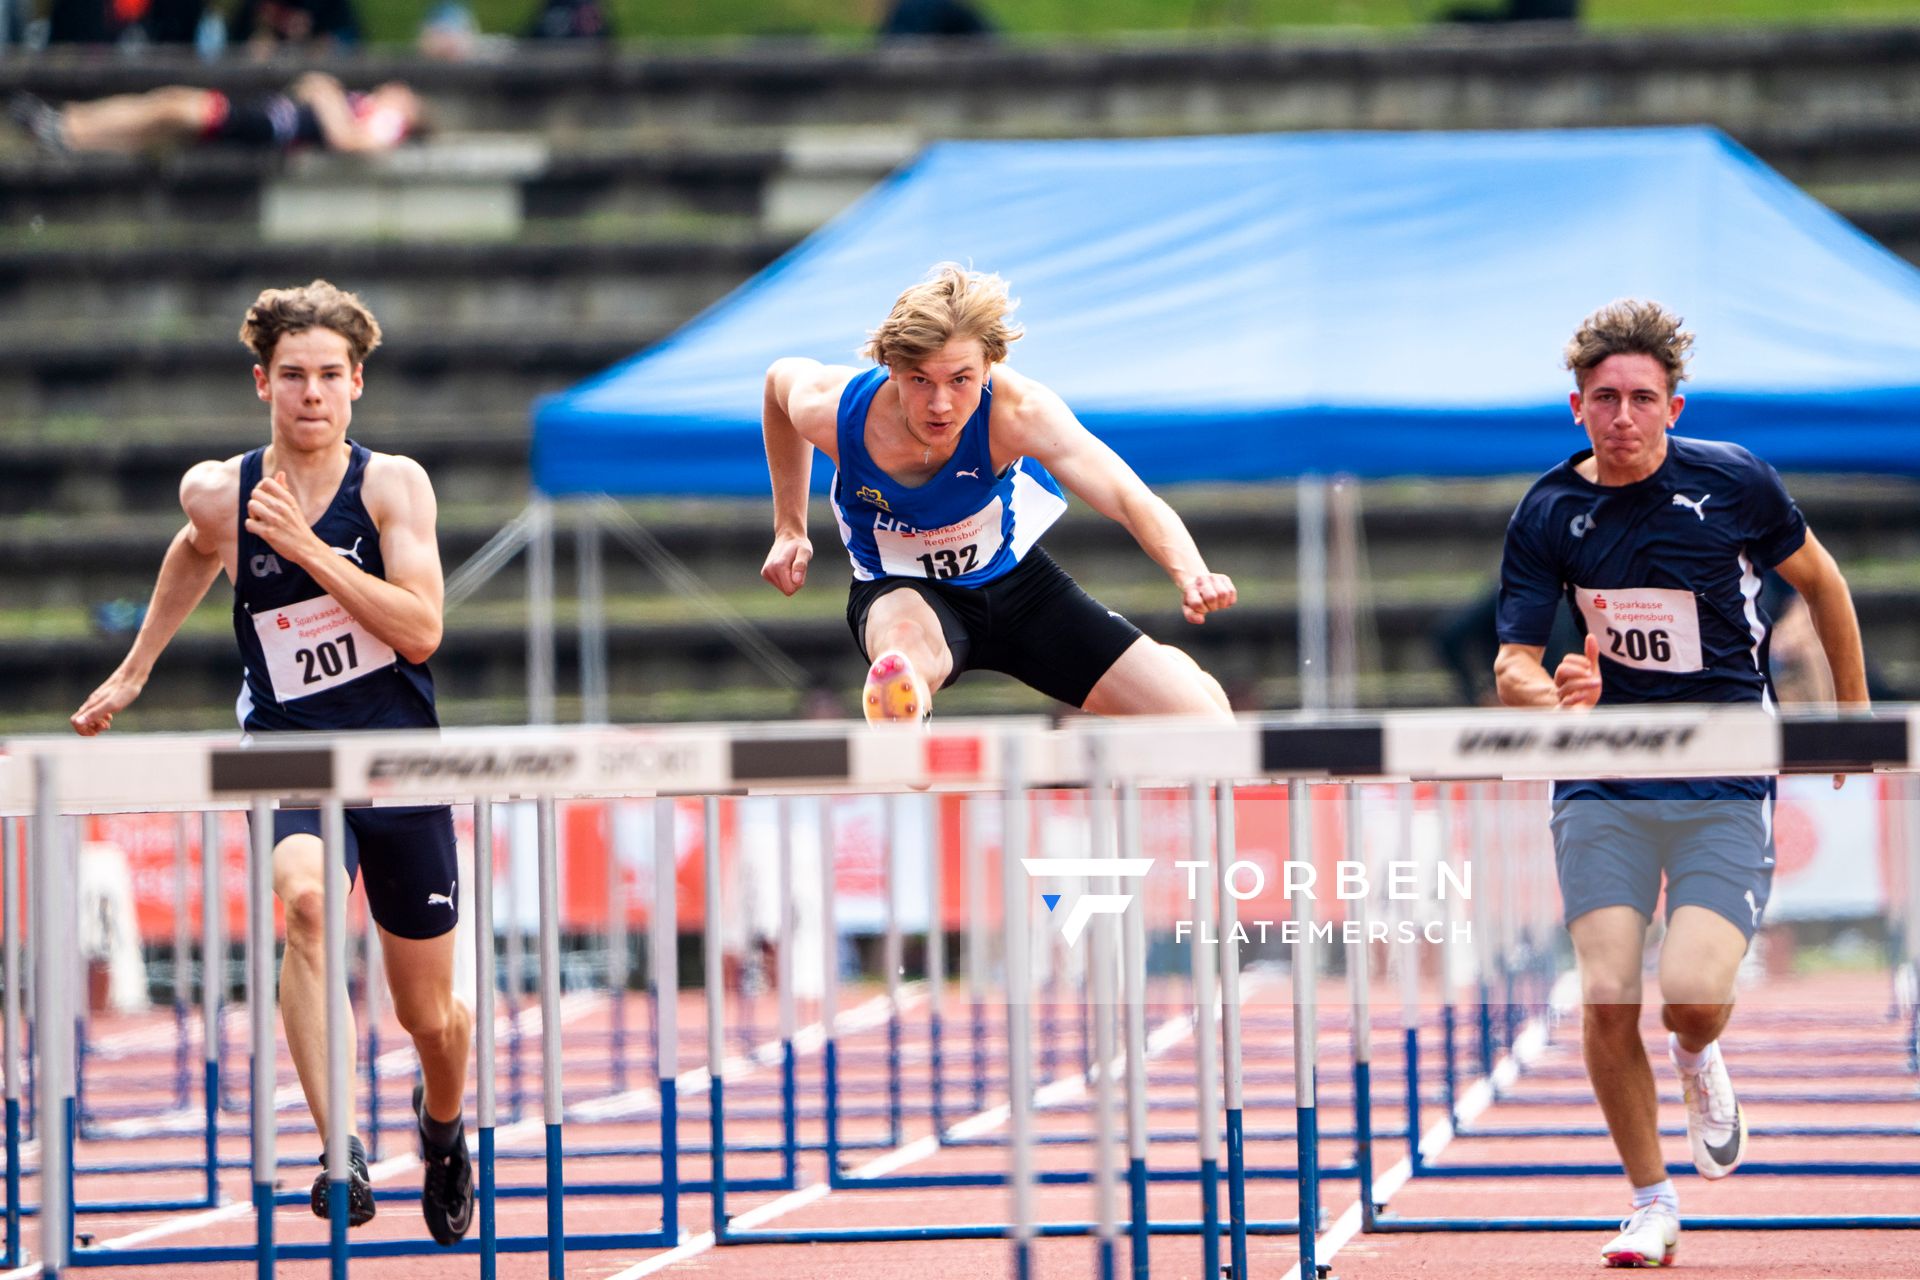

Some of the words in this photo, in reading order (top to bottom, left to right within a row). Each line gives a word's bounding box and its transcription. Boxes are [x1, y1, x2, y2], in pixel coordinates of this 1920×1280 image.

[921, 520, 973, 538] Sparkasse
[251, 554, 283, 577] CA
[916, 544, 979, 580] 132
[295, 606, 341, 626] Sparkasse
[1612, 601, 1663, 611] Sparkasse
[1614, 613, 1674, 623] Regensburg
[1606, 626, 1671, 662] 206
[295, 632, 358, 685] 207
